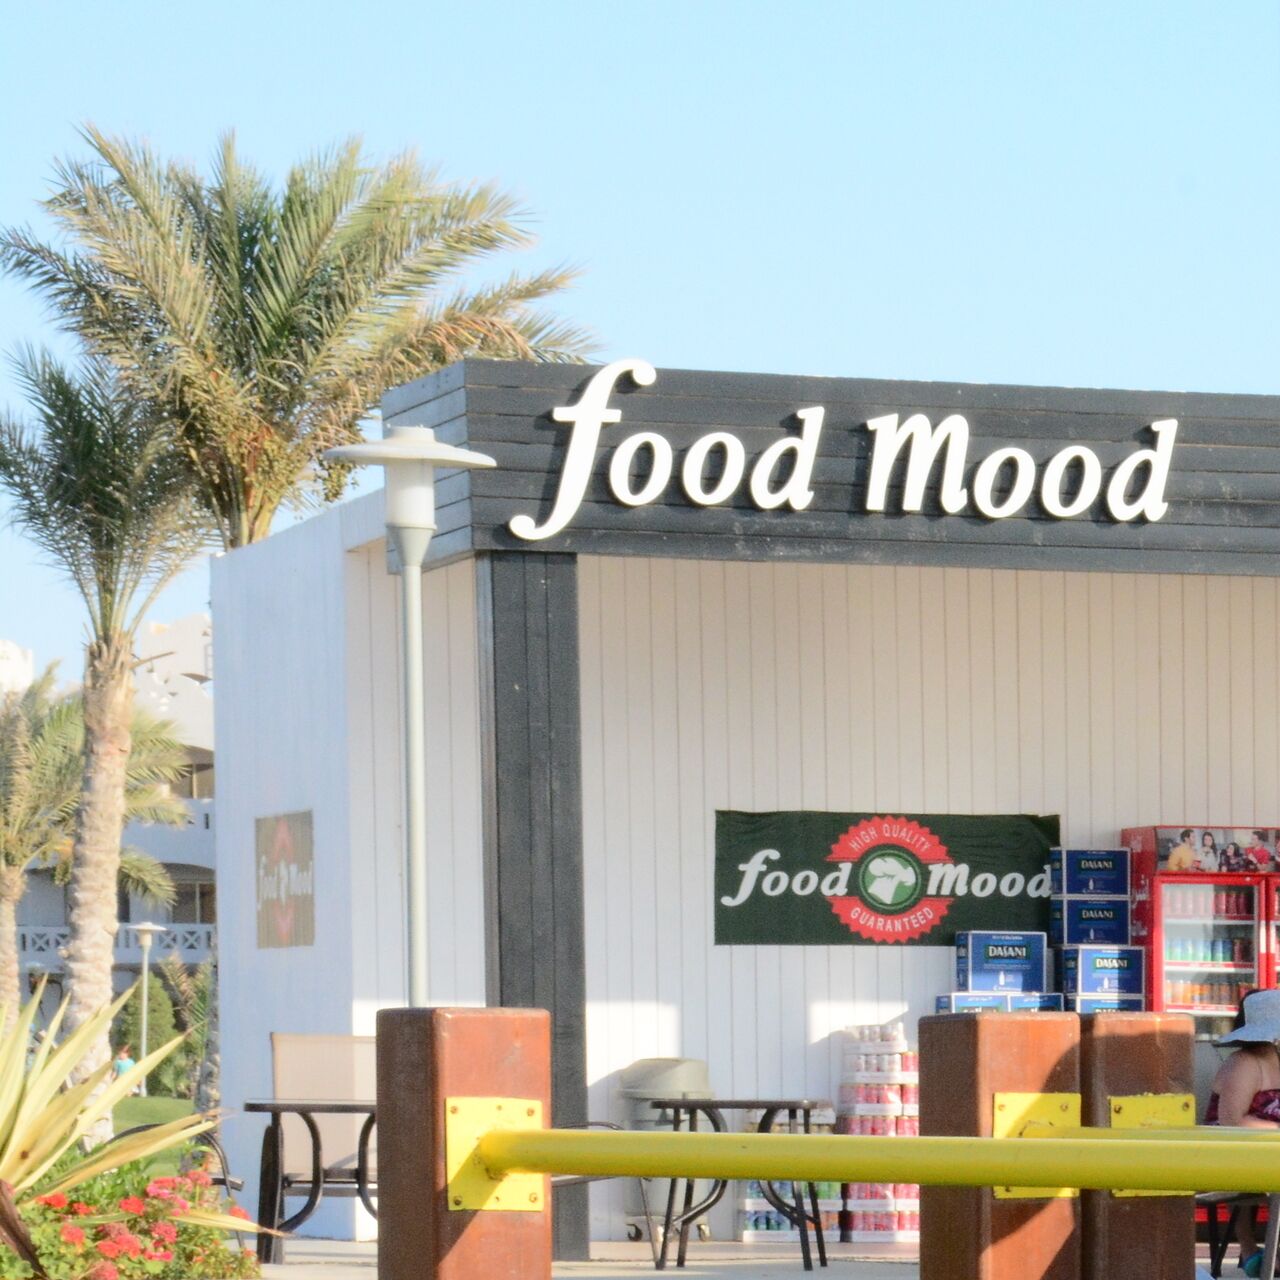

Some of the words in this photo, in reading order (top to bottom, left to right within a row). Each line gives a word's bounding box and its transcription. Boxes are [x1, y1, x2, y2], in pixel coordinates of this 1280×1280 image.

[509, 358, 825, 541] food
[849, 826, 879, 851] HIGH
[882, 823, 932, 852] QUALITY
[1081, 860, 1113, 869] DASANI
[720, 848, 853, 906] food
[850, 906, 935, 932] GUARANTEED
[1082, 909, 1114, 919] DASANI
[988, 945, 1027, 957] DASANI
[1095, 958, 1128, 968] DASANI
